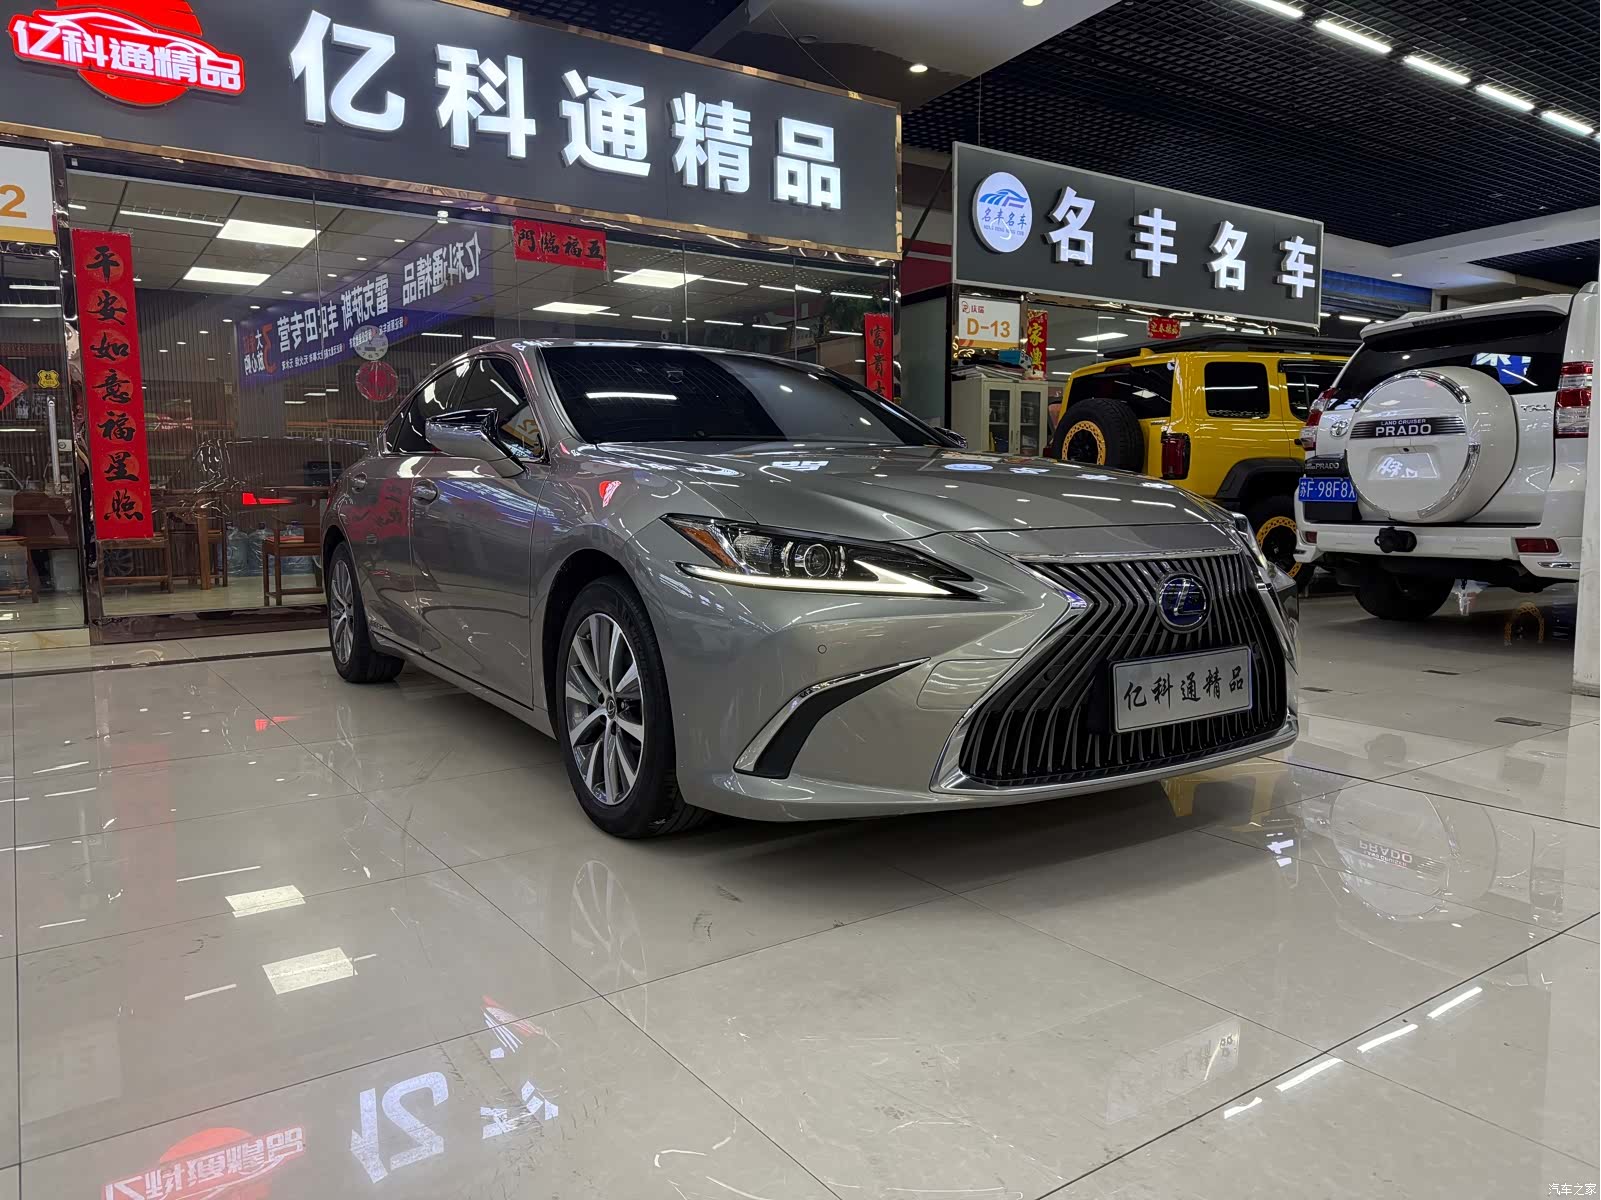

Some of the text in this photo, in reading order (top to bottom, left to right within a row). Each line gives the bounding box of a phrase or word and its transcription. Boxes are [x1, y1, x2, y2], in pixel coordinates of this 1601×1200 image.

[13, 20, 241, 91] 亿科通精品
[289, 9, 841, 210] 亿科通精品
[982, 207, 1027, 230] 名丰名车
[1046, 186, 1316, 298] 名丰名车
[967, 318, 1010, 338] D-13
[86, 245, 144, 521] 平安如意福星照
[1375, 424, 1432, 437] PRADO
[1315, 462, 1340, 470] PRADO
[1123, 665, 1244, 712] 亿科通精品
